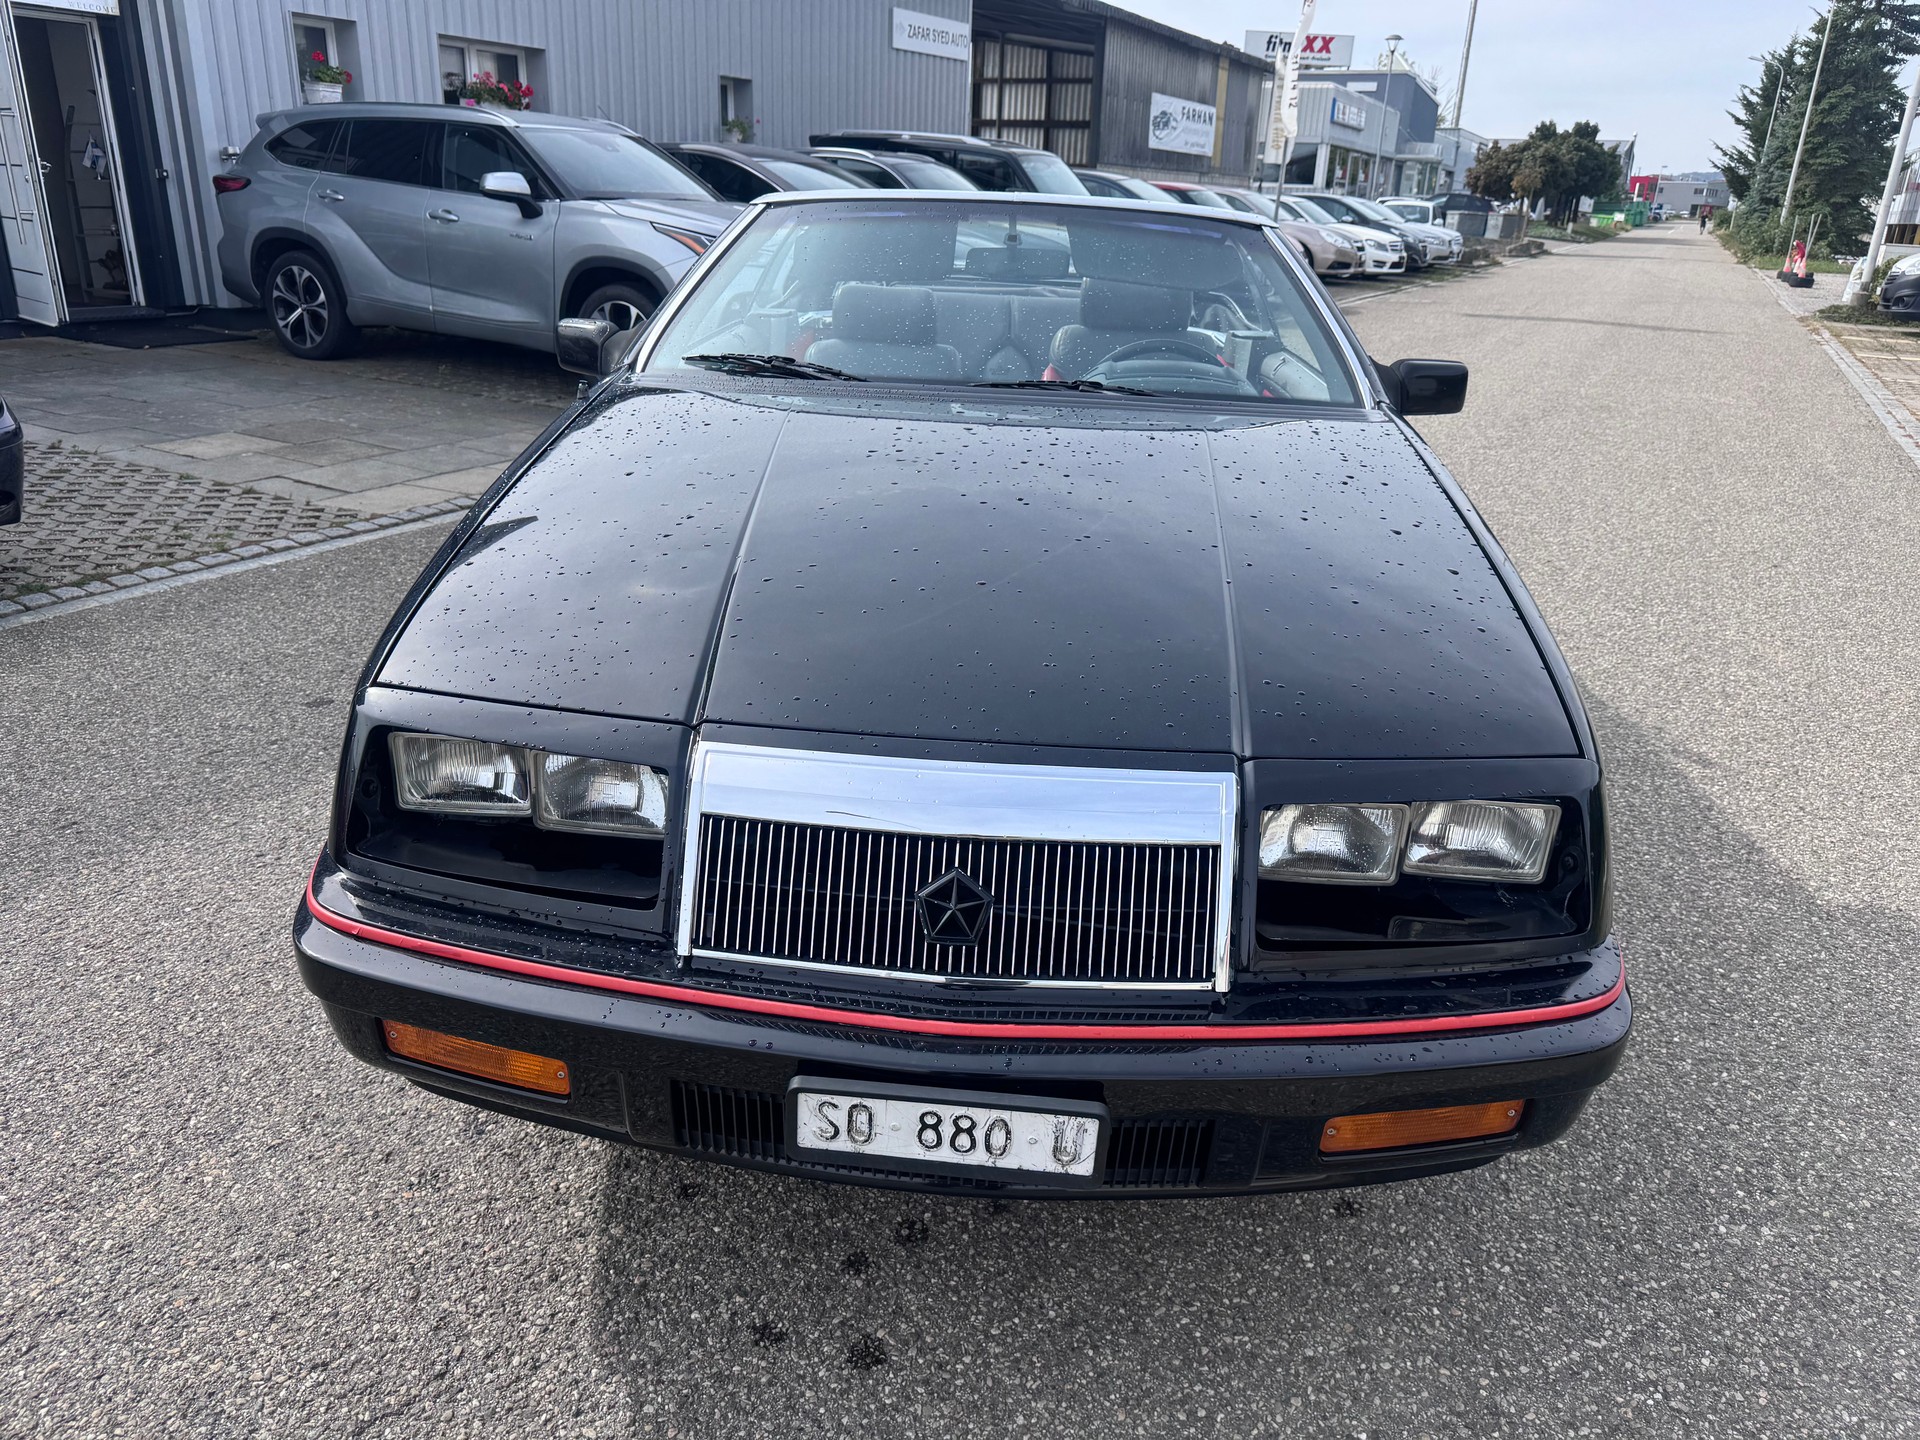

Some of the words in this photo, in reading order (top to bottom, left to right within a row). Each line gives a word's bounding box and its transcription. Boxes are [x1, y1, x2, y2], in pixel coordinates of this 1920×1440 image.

[907, 24, 931, 42] ZAFAR
[932, 29, 950, 45] SYED
[951, 33, 968, 48] AUTO
[1265, 34, 1336, 54] fitnXX
[1181, 105, 1214, 127] FARHAN
[814, 1100, 874, 1144] SO
[916, 1109, 1012, 1158] 880
[1052, 1115, 1088, 1166] U
